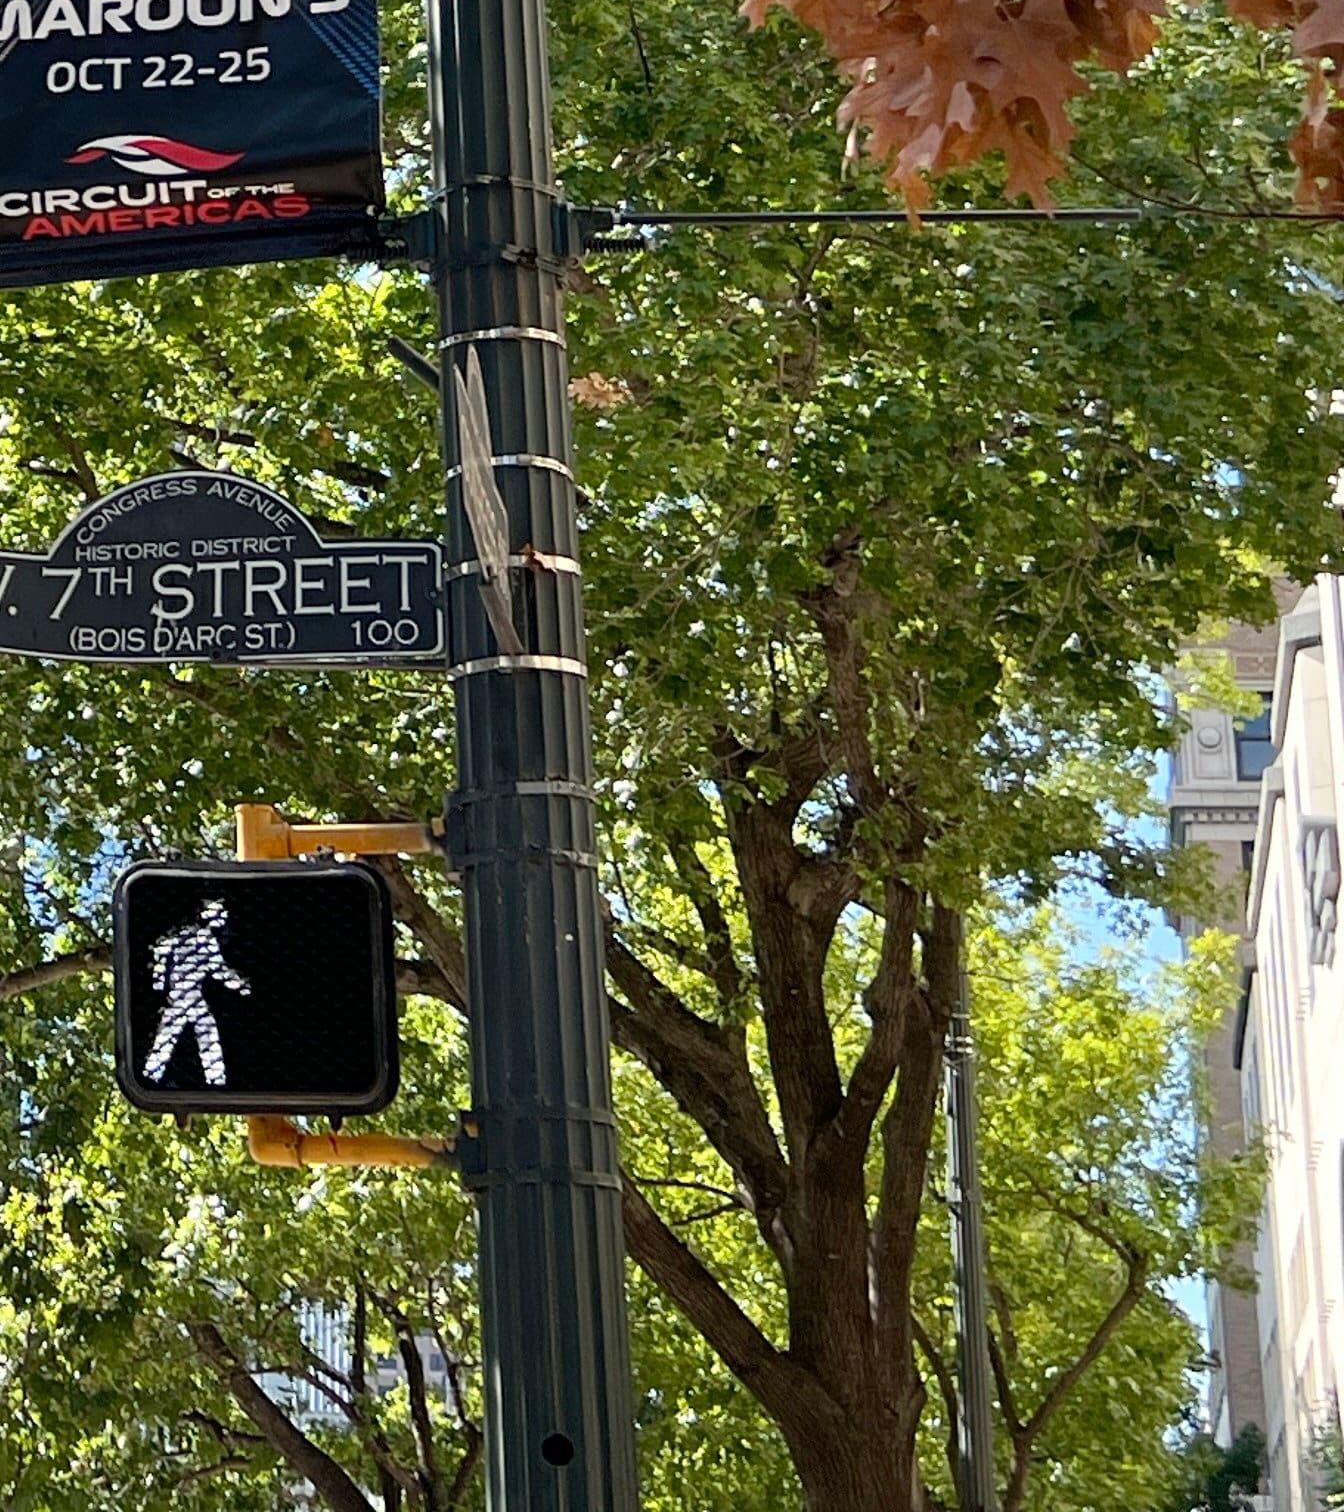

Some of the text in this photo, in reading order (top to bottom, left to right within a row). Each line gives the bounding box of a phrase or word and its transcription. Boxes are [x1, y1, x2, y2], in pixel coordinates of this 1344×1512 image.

[46, 46, 271, 94] OCT 22-25
[207, 185, 241, 199] OF
[244, 182, 296, 196] THE
[22, 196, 311, 240] AMERICAS
[76, 478, 296, 545] CONGRESS AVENUE
[75, 535, 297, 563] HISTORIC DISTRICT
[41, 565, 134, 621] 7TH
[150, 553, 429, 620] STREET
[69, 625, 146, 653] (BOIS
[154, 624, 238, 653] D'ARC
[350, 618, 421, 648] 100
